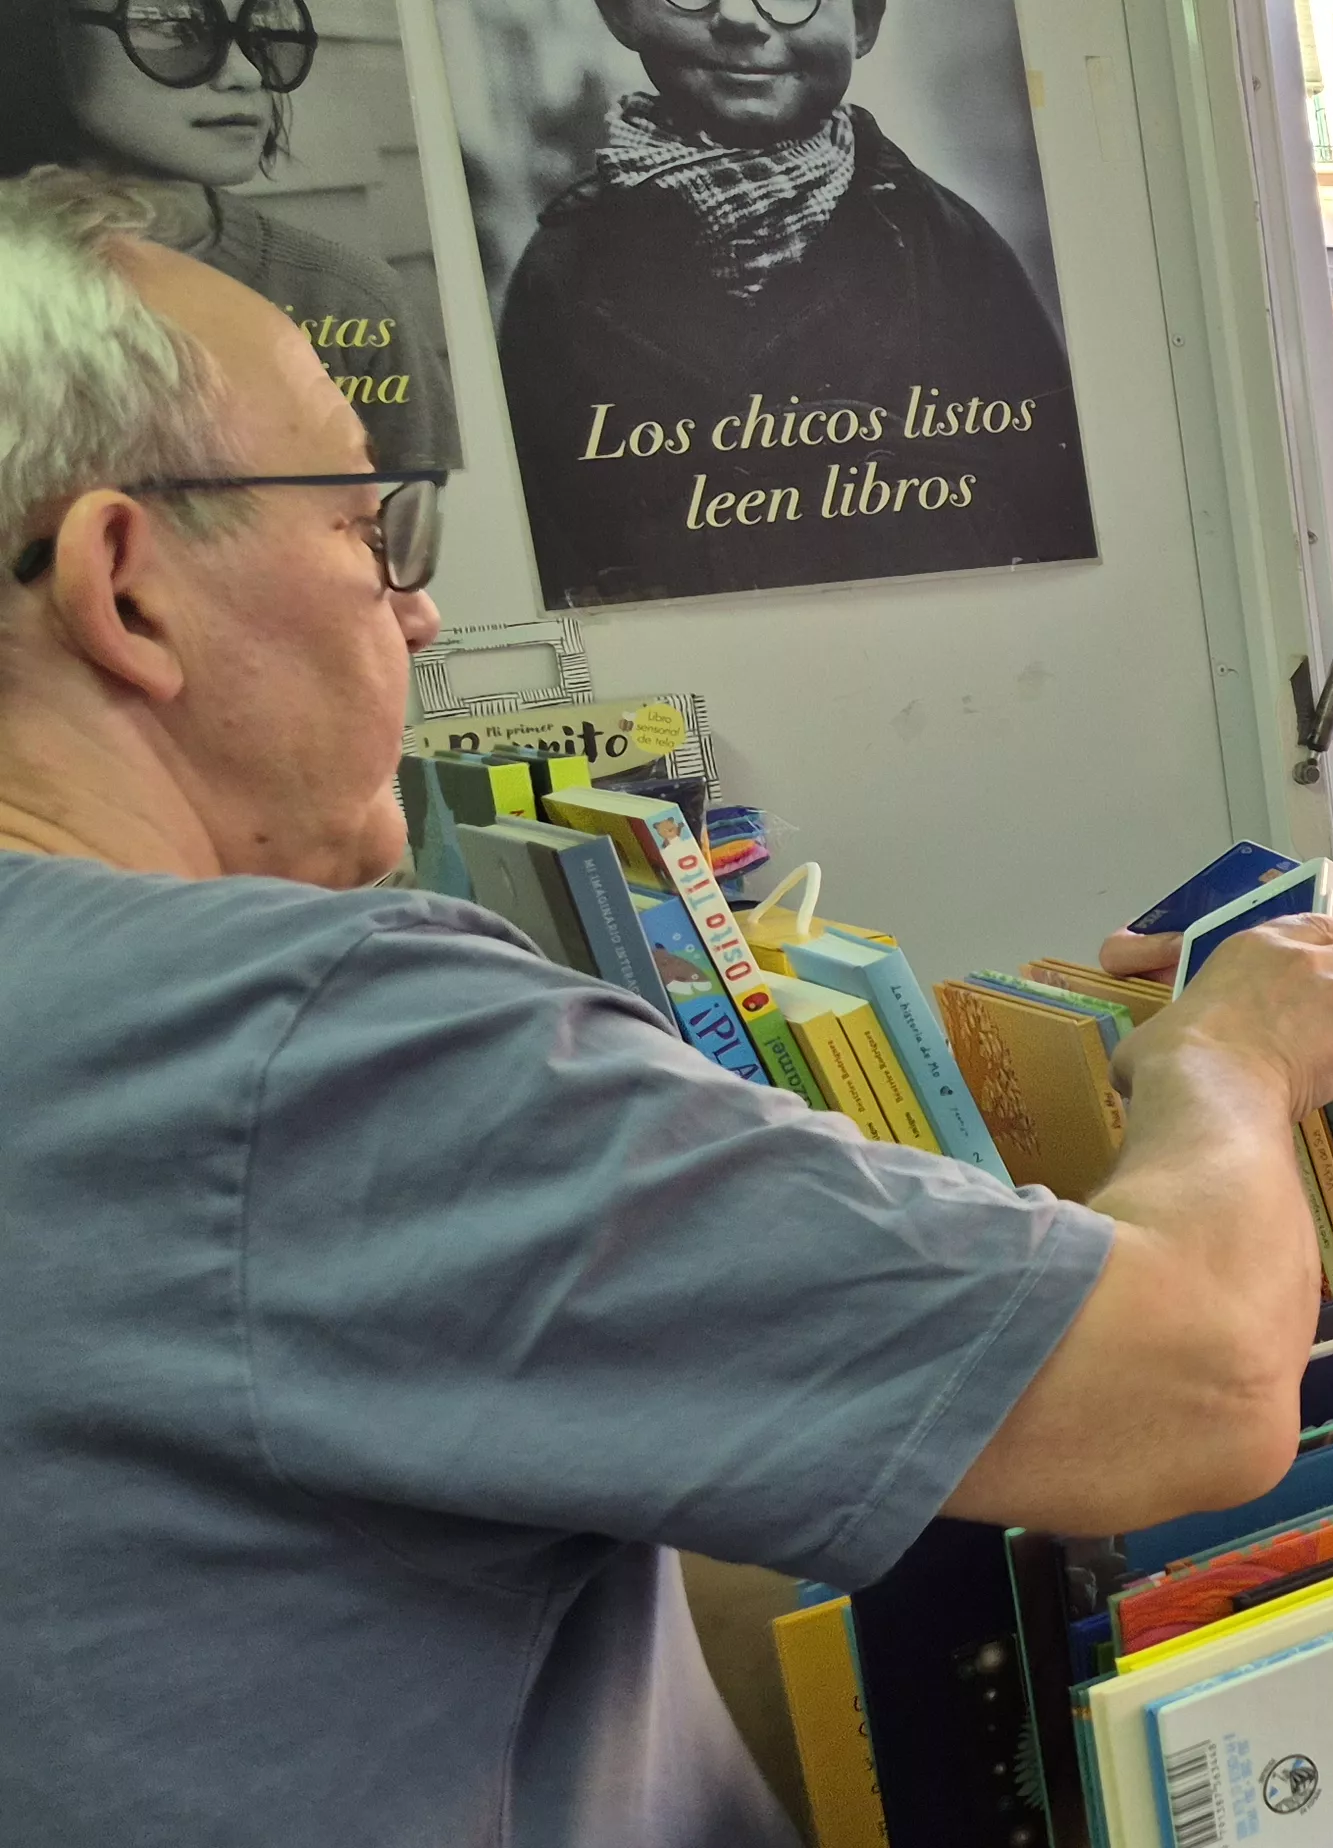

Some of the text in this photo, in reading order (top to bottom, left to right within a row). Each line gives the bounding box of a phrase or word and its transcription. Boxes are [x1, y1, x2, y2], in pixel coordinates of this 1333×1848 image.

[285, 305, 396, 348] stas
[322, 362, 410, 404] ma
[577, 384, 1037, 461] Los chicos listos
[685, 463, 976, 530] leen libros
[486, 723, 553, 741] Mi primer
[635, 723, 680, 737] sensorial
[647, 711, 672, 725] Libro
[636, 734, 676, 749] de tela
[583, 858, 597, 875] MI
[590, 875, 622, 945] IMAGINARIO
[677, 854, 752, 982] Osito Tito
[889, 984, 941, 1079] La historia de Mo
